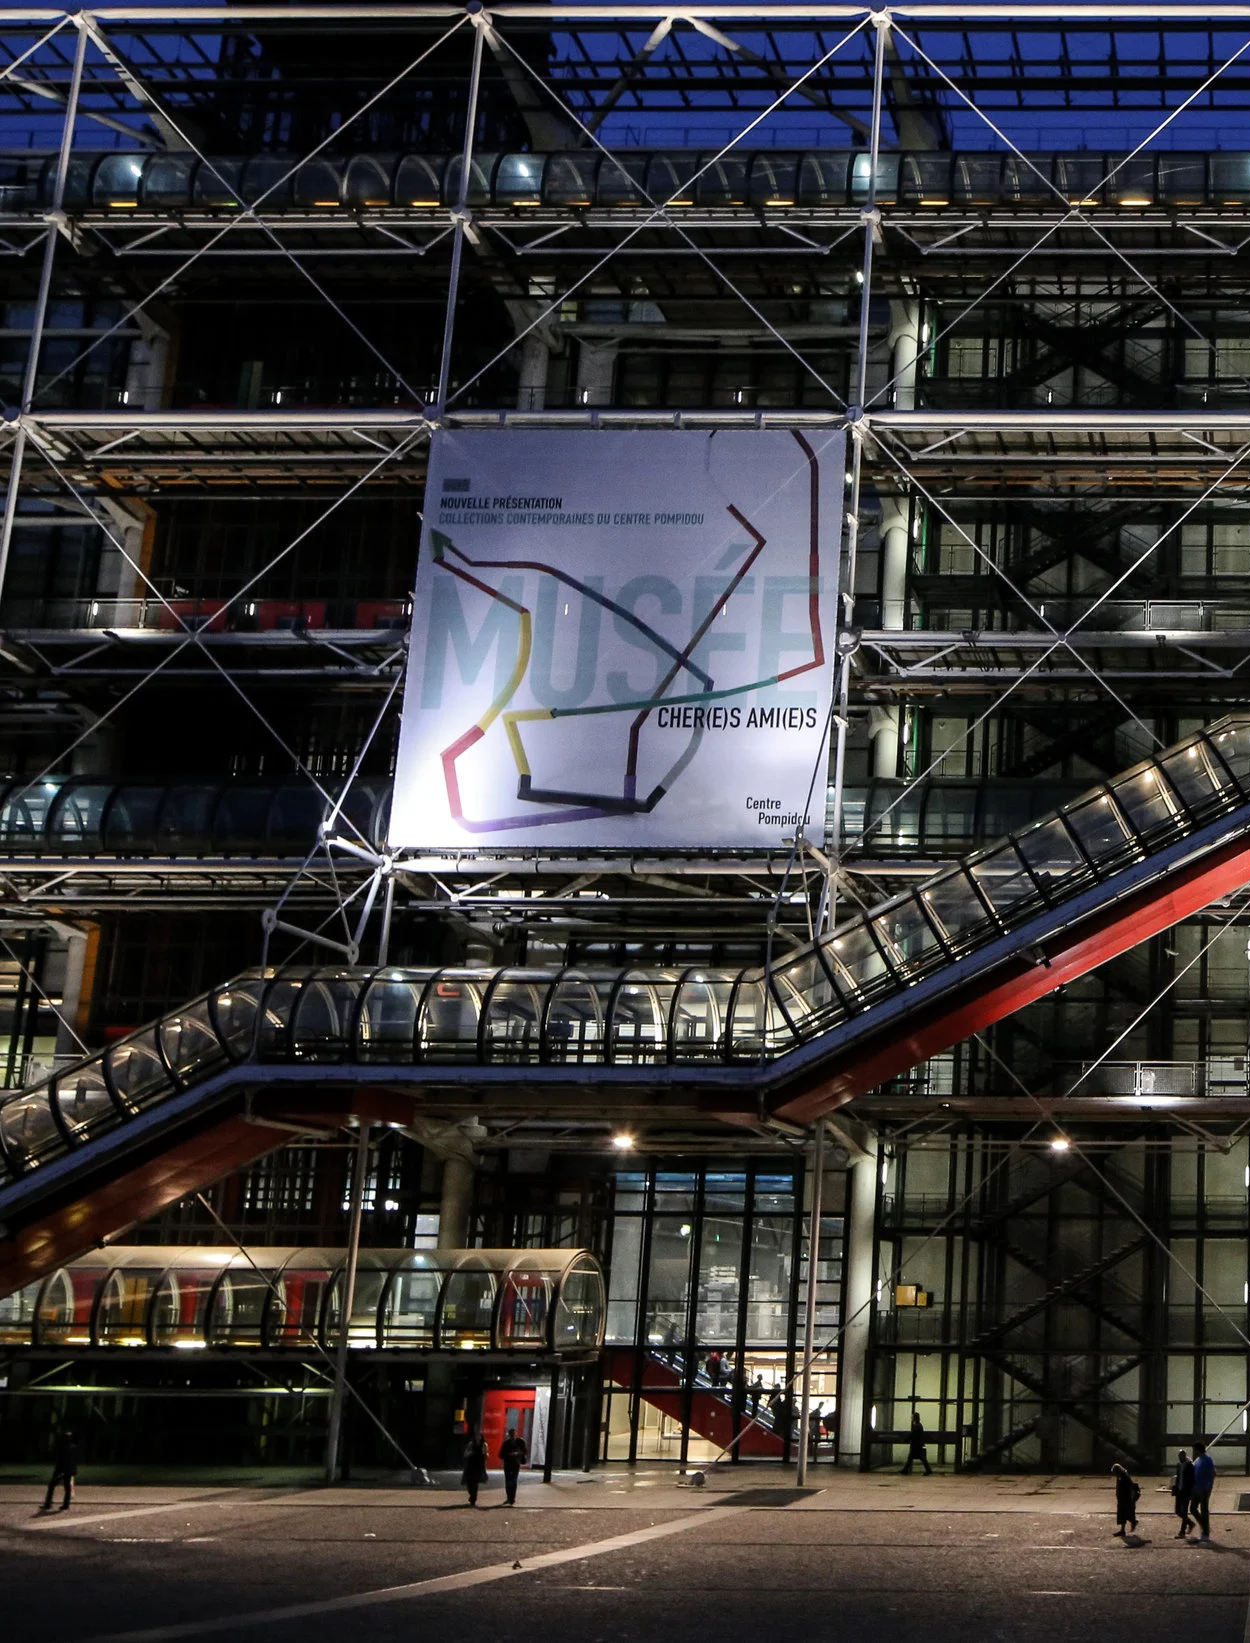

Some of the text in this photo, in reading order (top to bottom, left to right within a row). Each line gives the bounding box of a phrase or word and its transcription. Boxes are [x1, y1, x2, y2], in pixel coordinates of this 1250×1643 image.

[440, 496, 562, 509] NOUVELLE PRÉSENTATION
[439, 513, 704, 525] COLLECTIONS CONTEMPORAINES DU CENTRE POMPIDOU
[420, 543, 825, 710] MUSÉE
[658, 707, 817, 731] CHER(E)S AMI(E)S
[746, 797, 782, 809] Centre
